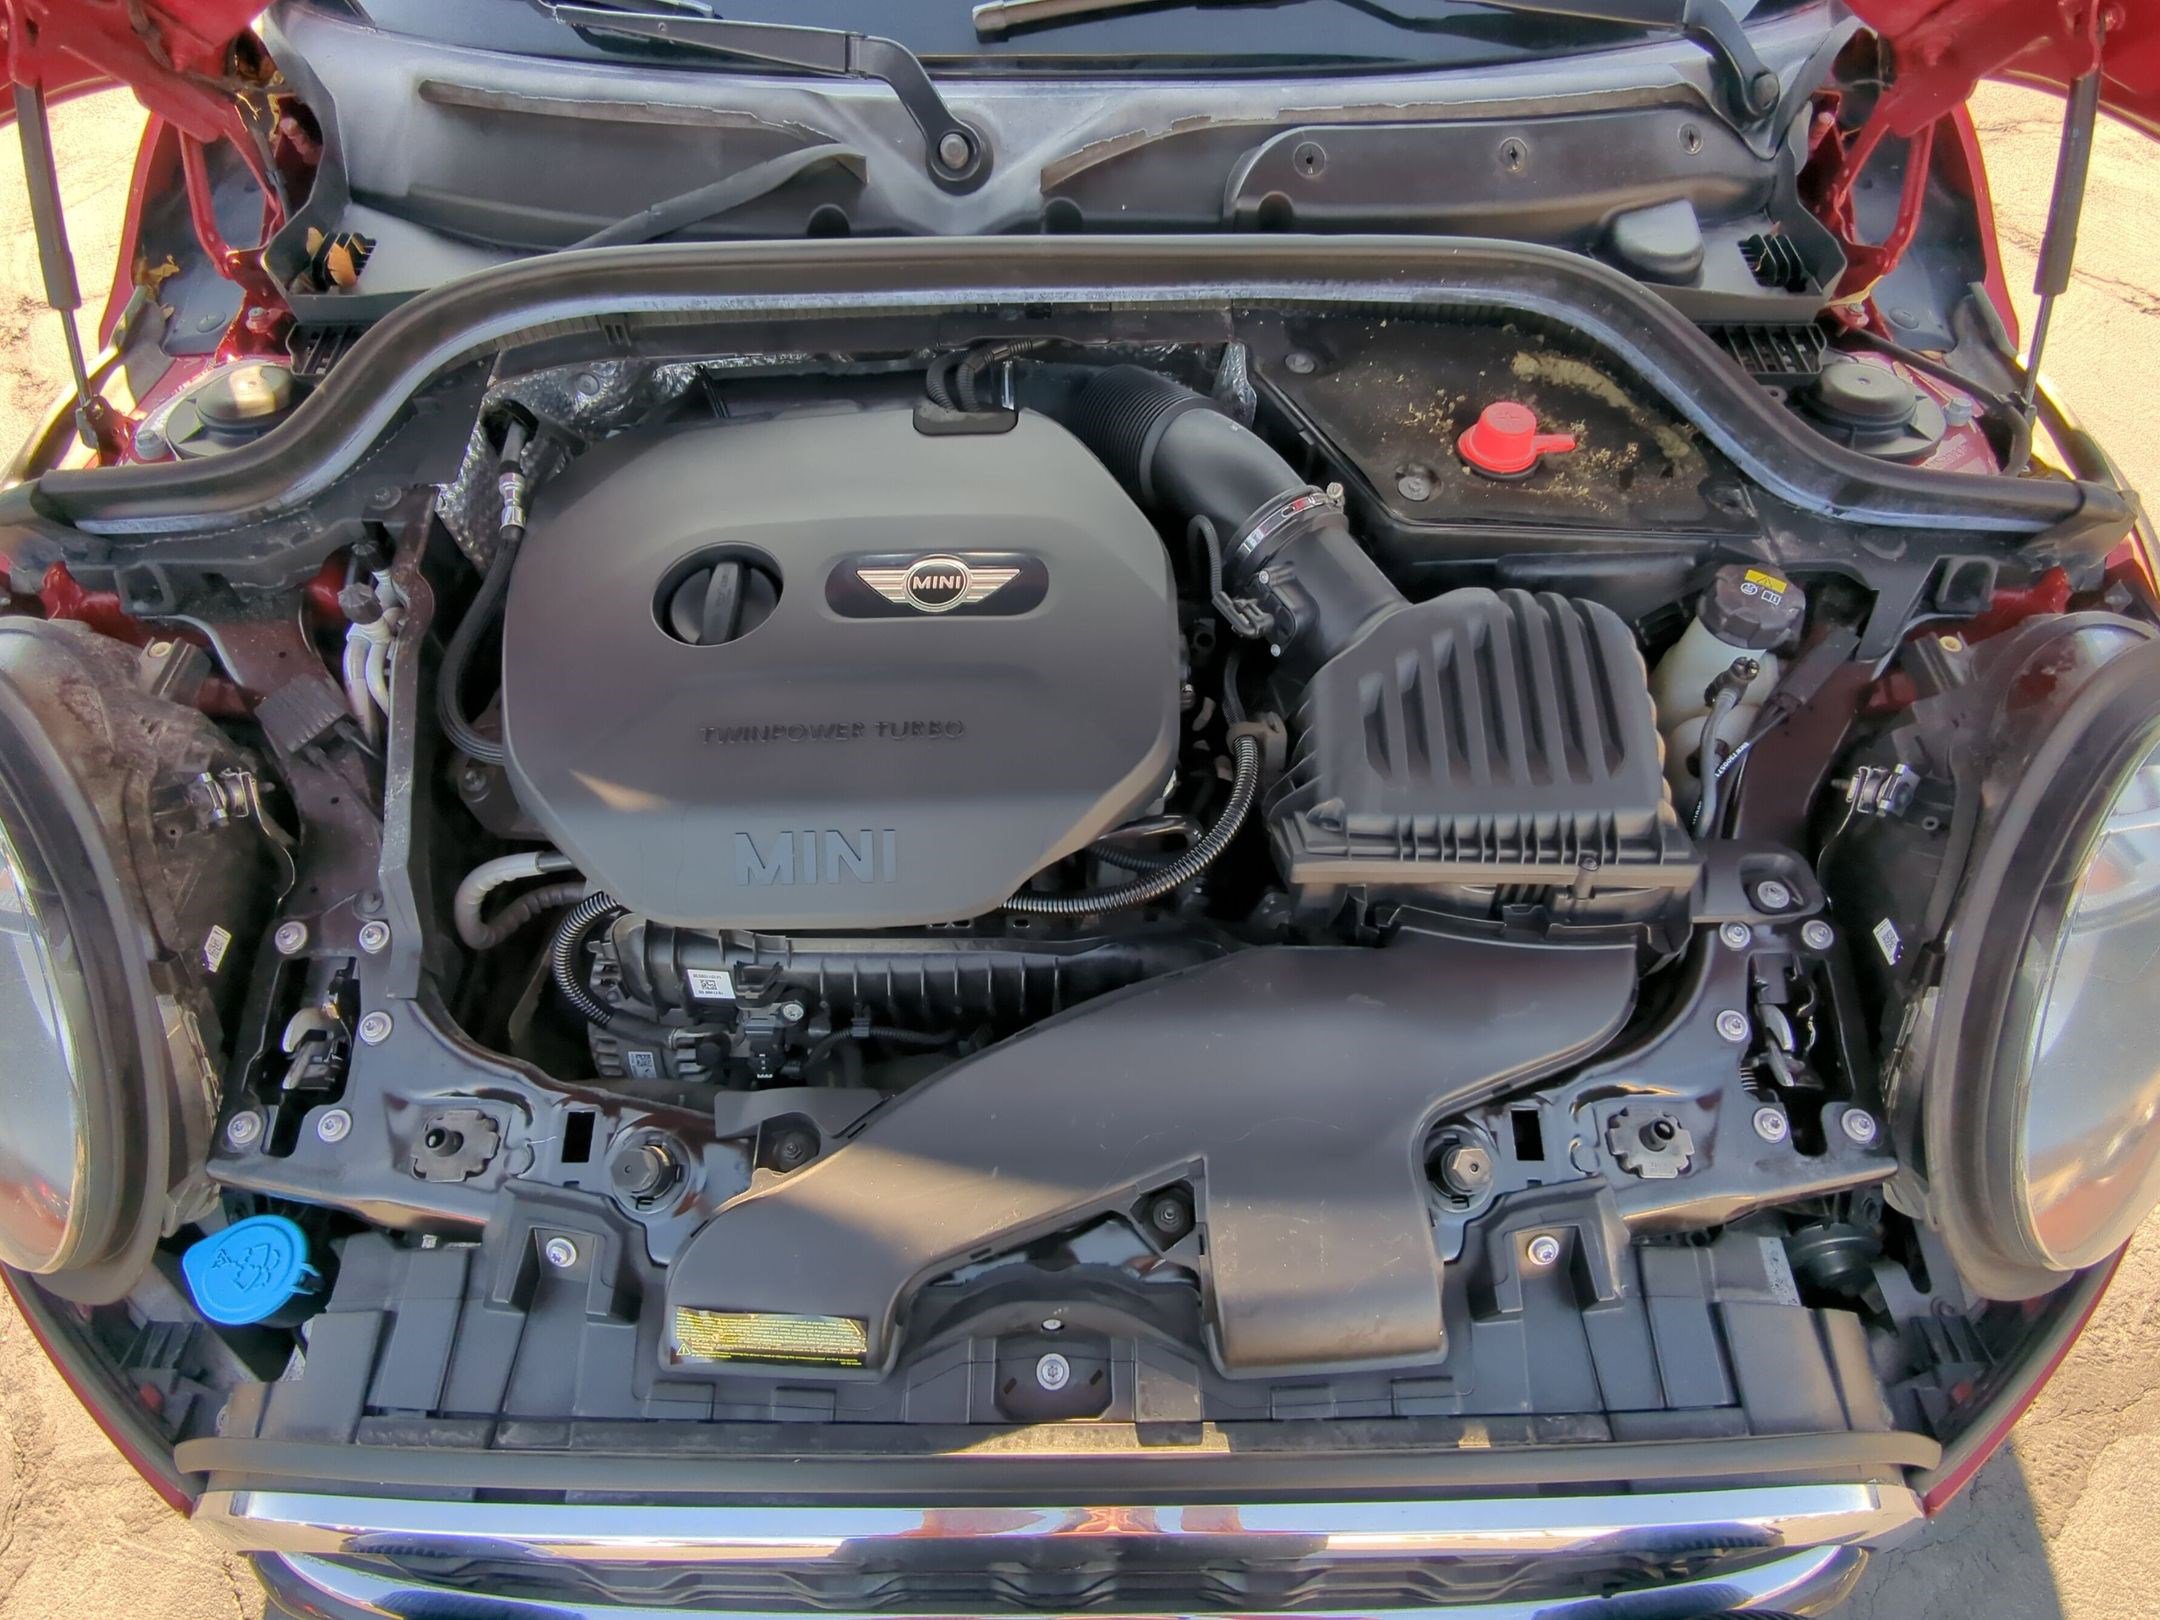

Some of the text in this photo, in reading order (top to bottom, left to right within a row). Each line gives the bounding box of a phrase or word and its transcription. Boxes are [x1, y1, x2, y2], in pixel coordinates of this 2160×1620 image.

[912, 575, 961, 589] MINI
[700, 718, 966, 745] TWINPOWER TURBO
[734, 828, 897, 887] MINI
